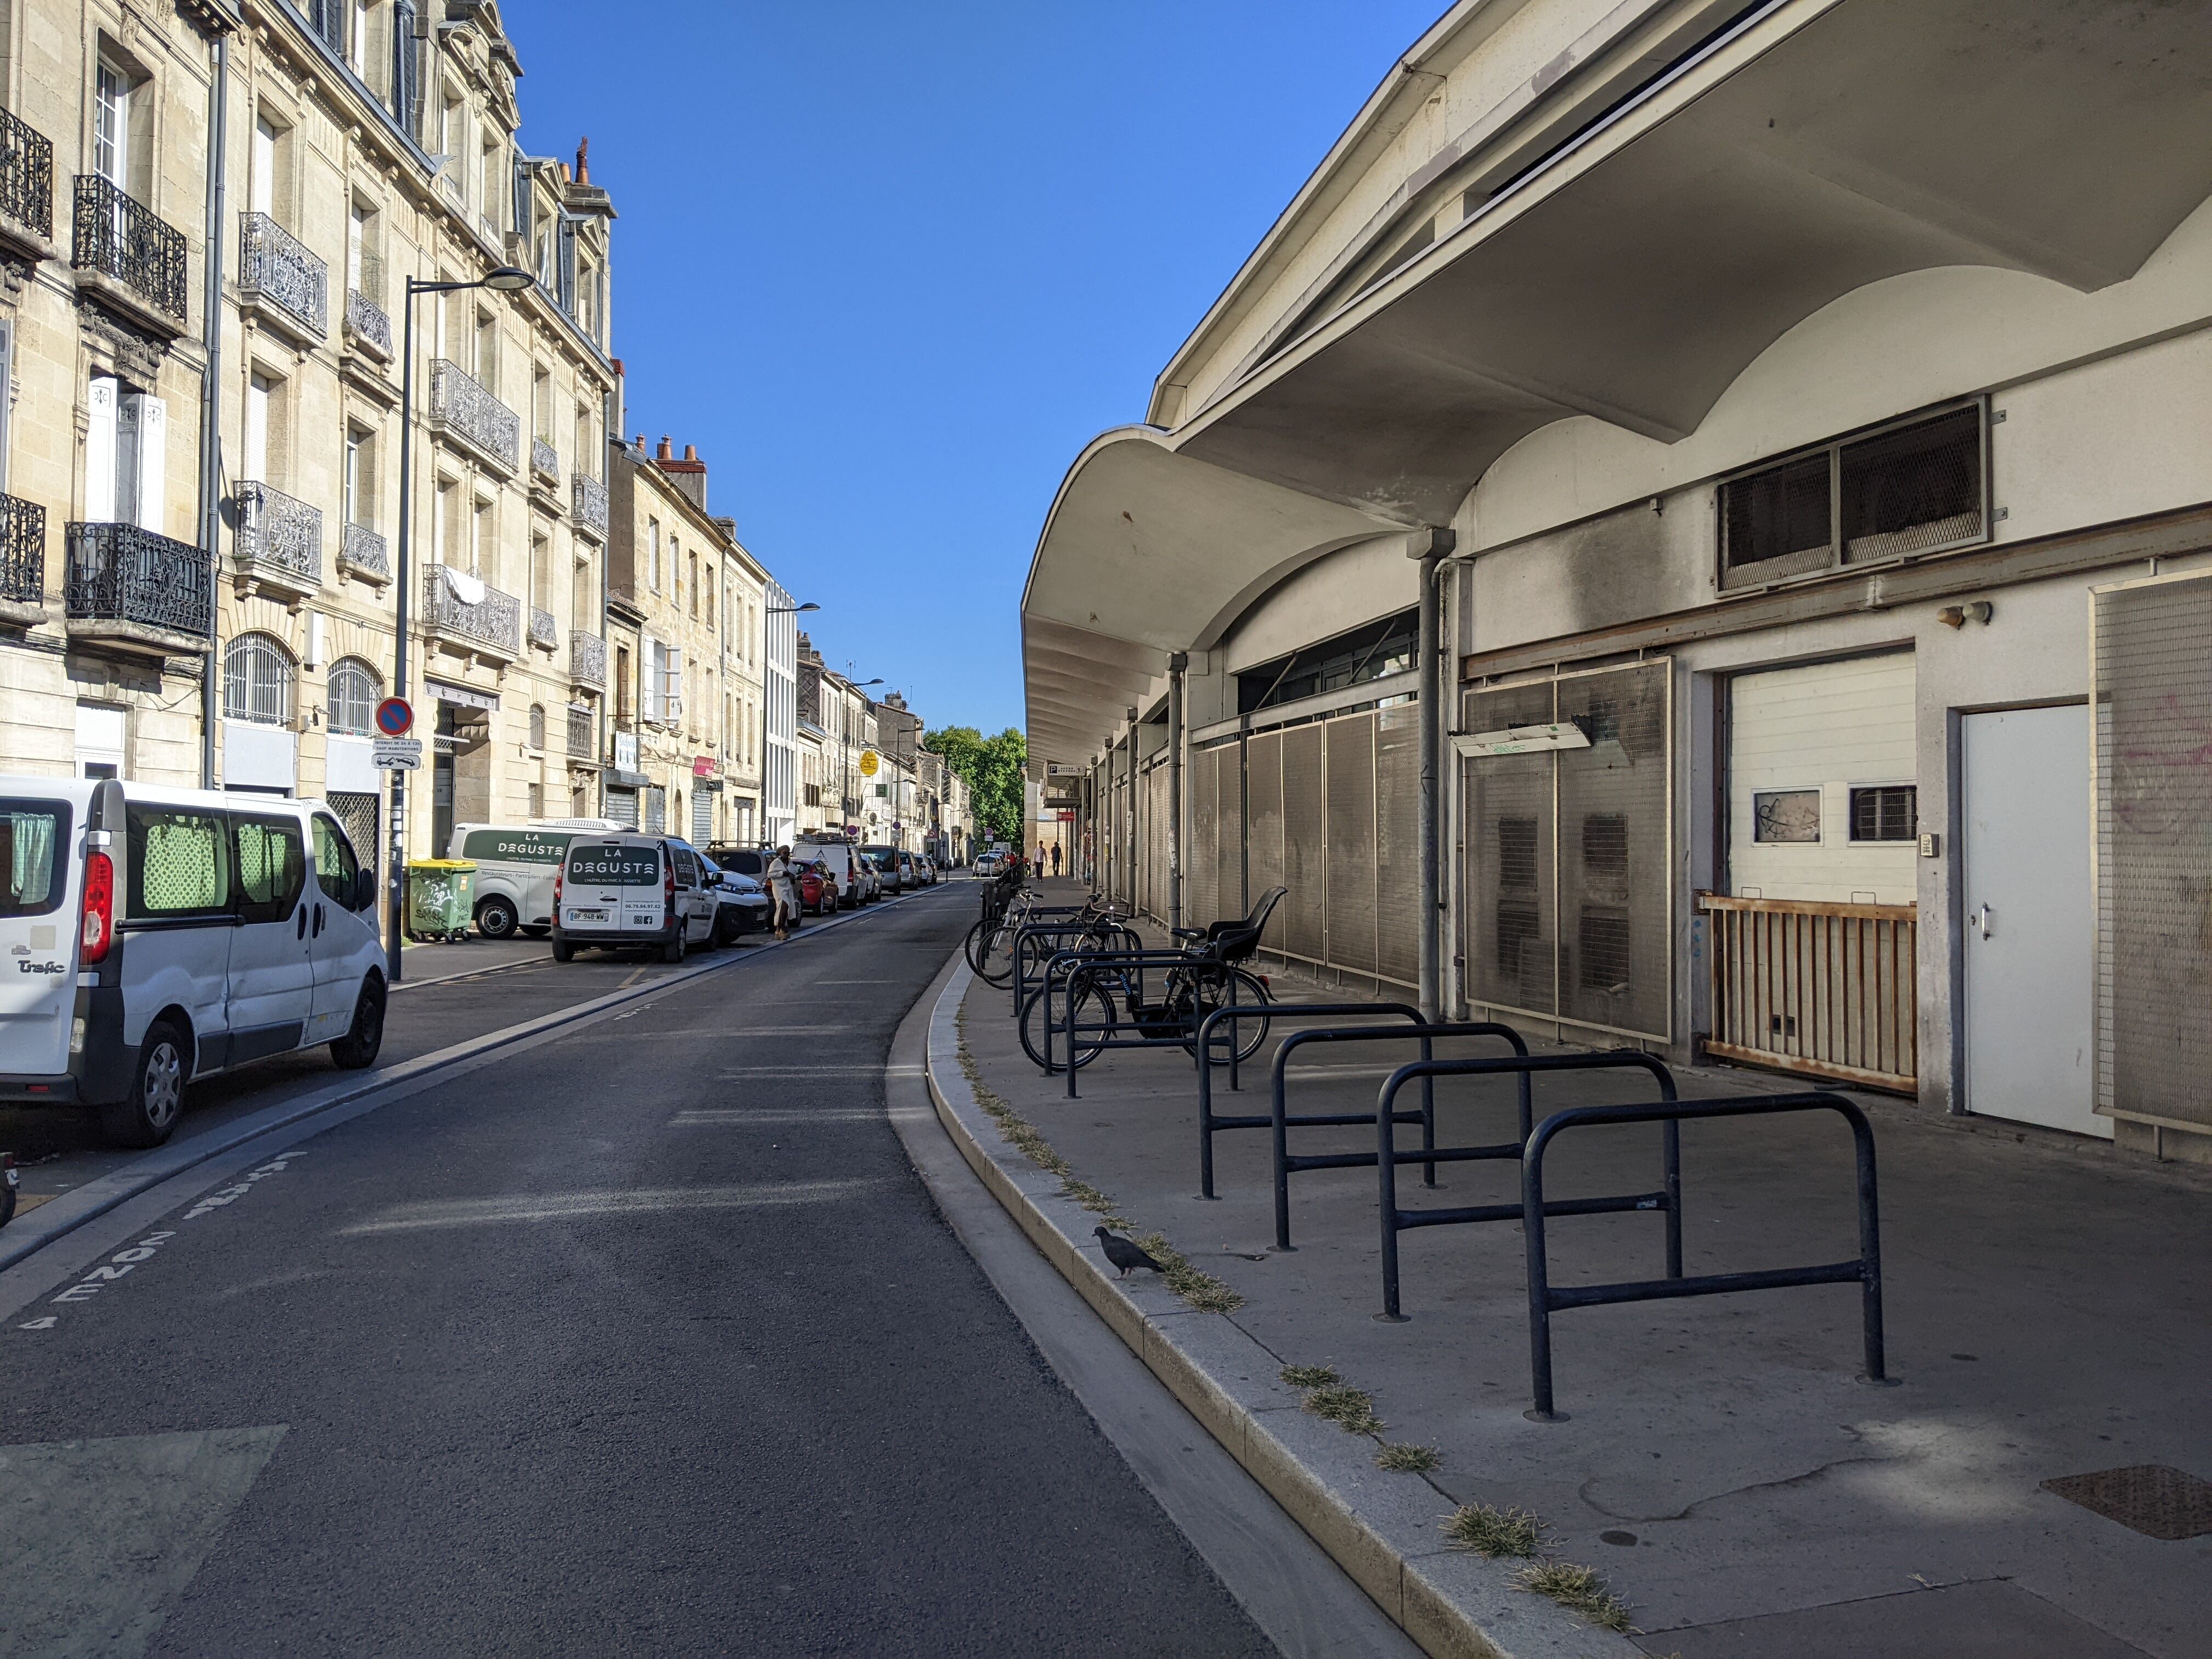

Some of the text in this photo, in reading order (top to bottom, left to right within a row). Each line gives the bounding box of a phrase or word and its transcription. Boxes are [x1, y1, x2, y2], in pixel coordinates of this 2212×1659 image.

[498, 843, 563, 856] DEGUSTE
[656, 840, 663, 850] 2
[604, 848, 622, 857] LA
[573, 861, 654, 874] DEGUSTE
[17, 960, 66, 975] Trafic
[1119, 974, 1131, 995] btwin
[50, 1231, 177, 1303] ZONE
